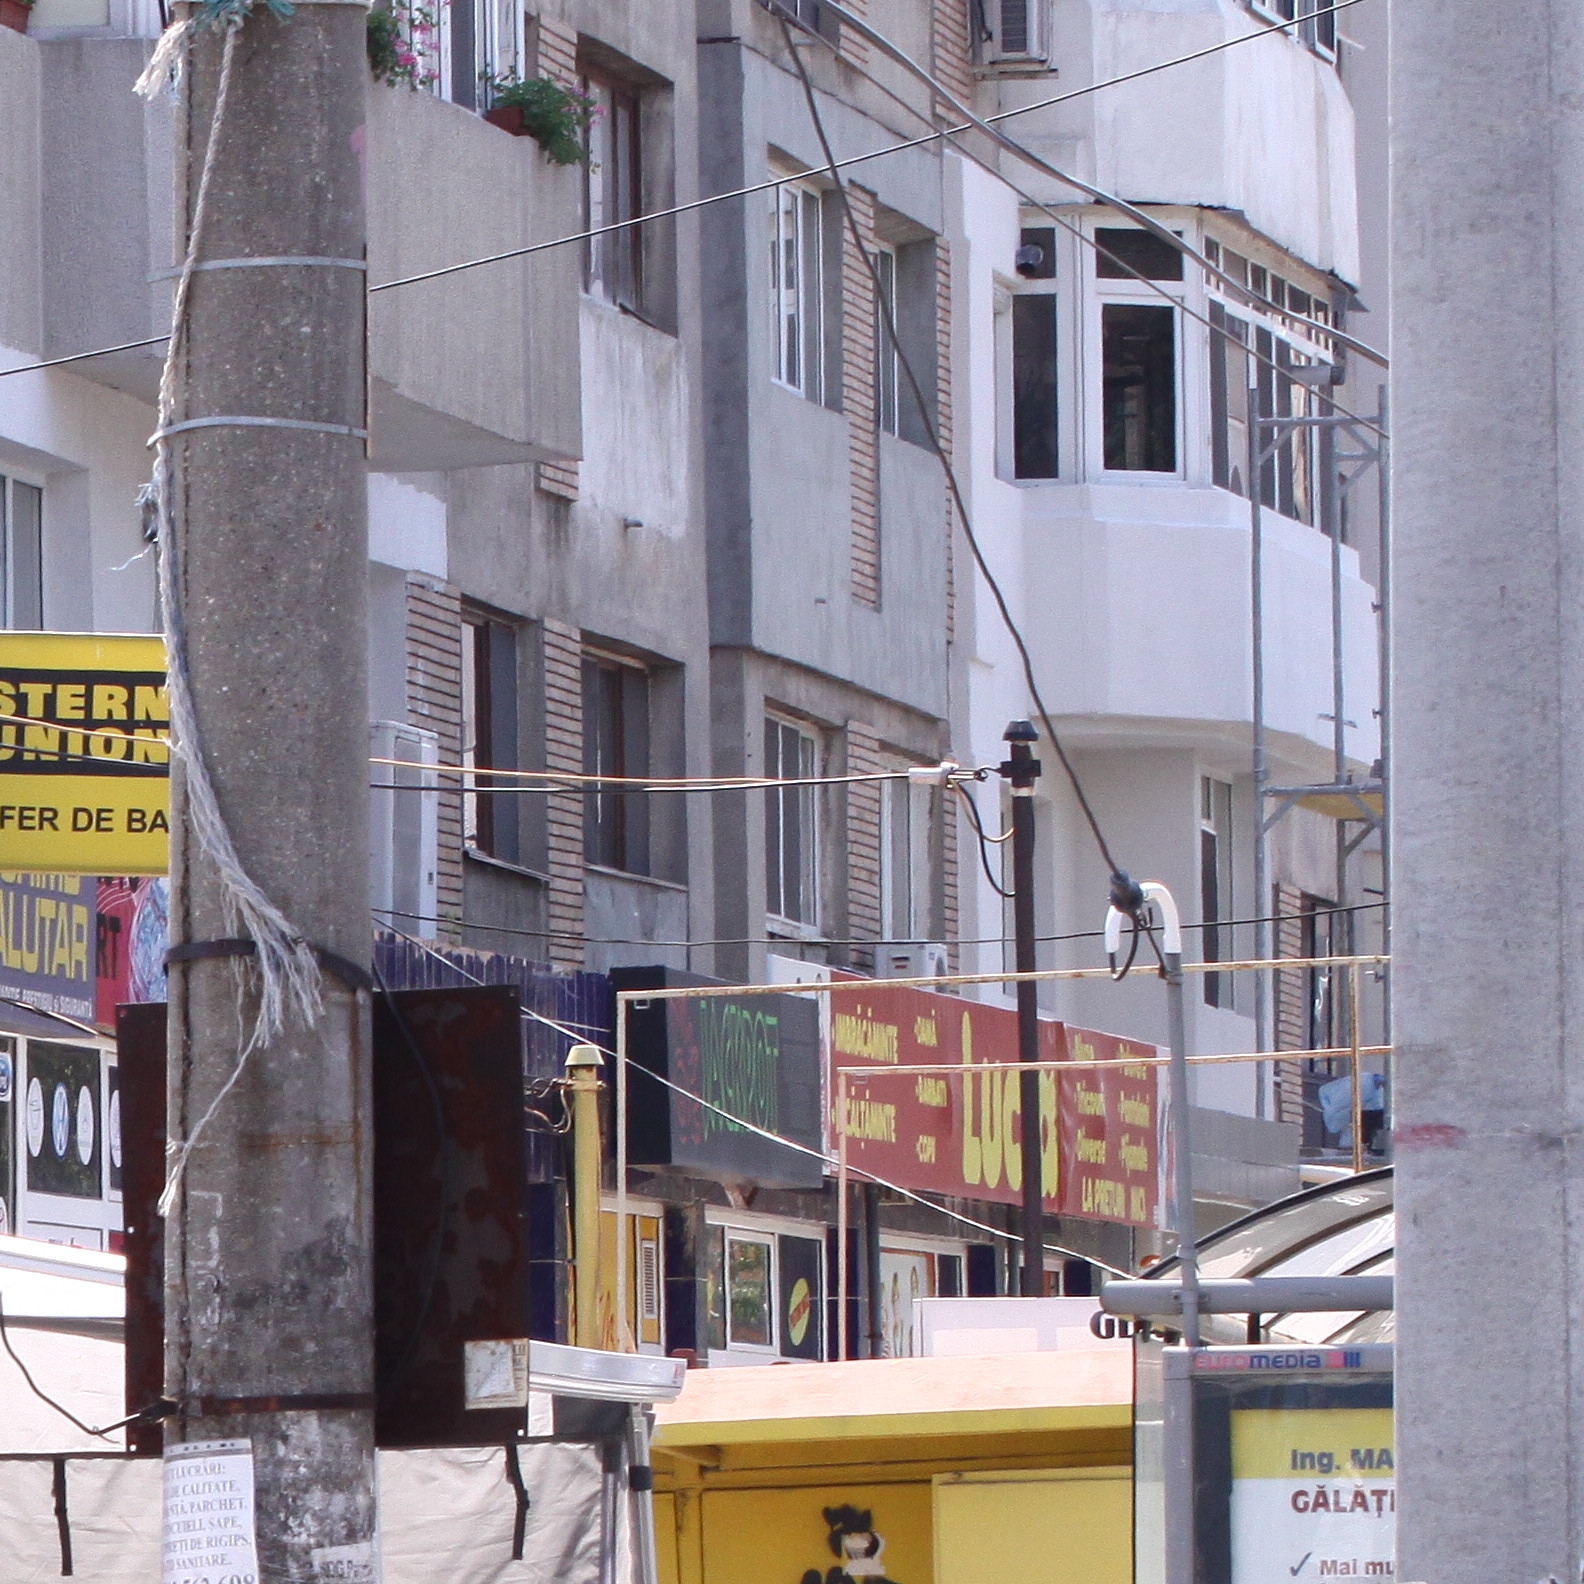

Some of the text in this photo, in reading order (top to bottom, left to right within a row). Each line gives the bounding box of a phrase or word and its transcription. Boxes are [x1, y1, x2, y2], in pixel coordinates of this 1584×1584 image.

[72, 807, 113, 832] DE
[127, 810, 169, 834] BA
[1291, 1449, 1394, 1473] Ing. MA
[1320, 1560, 1357, 1575] Mai
